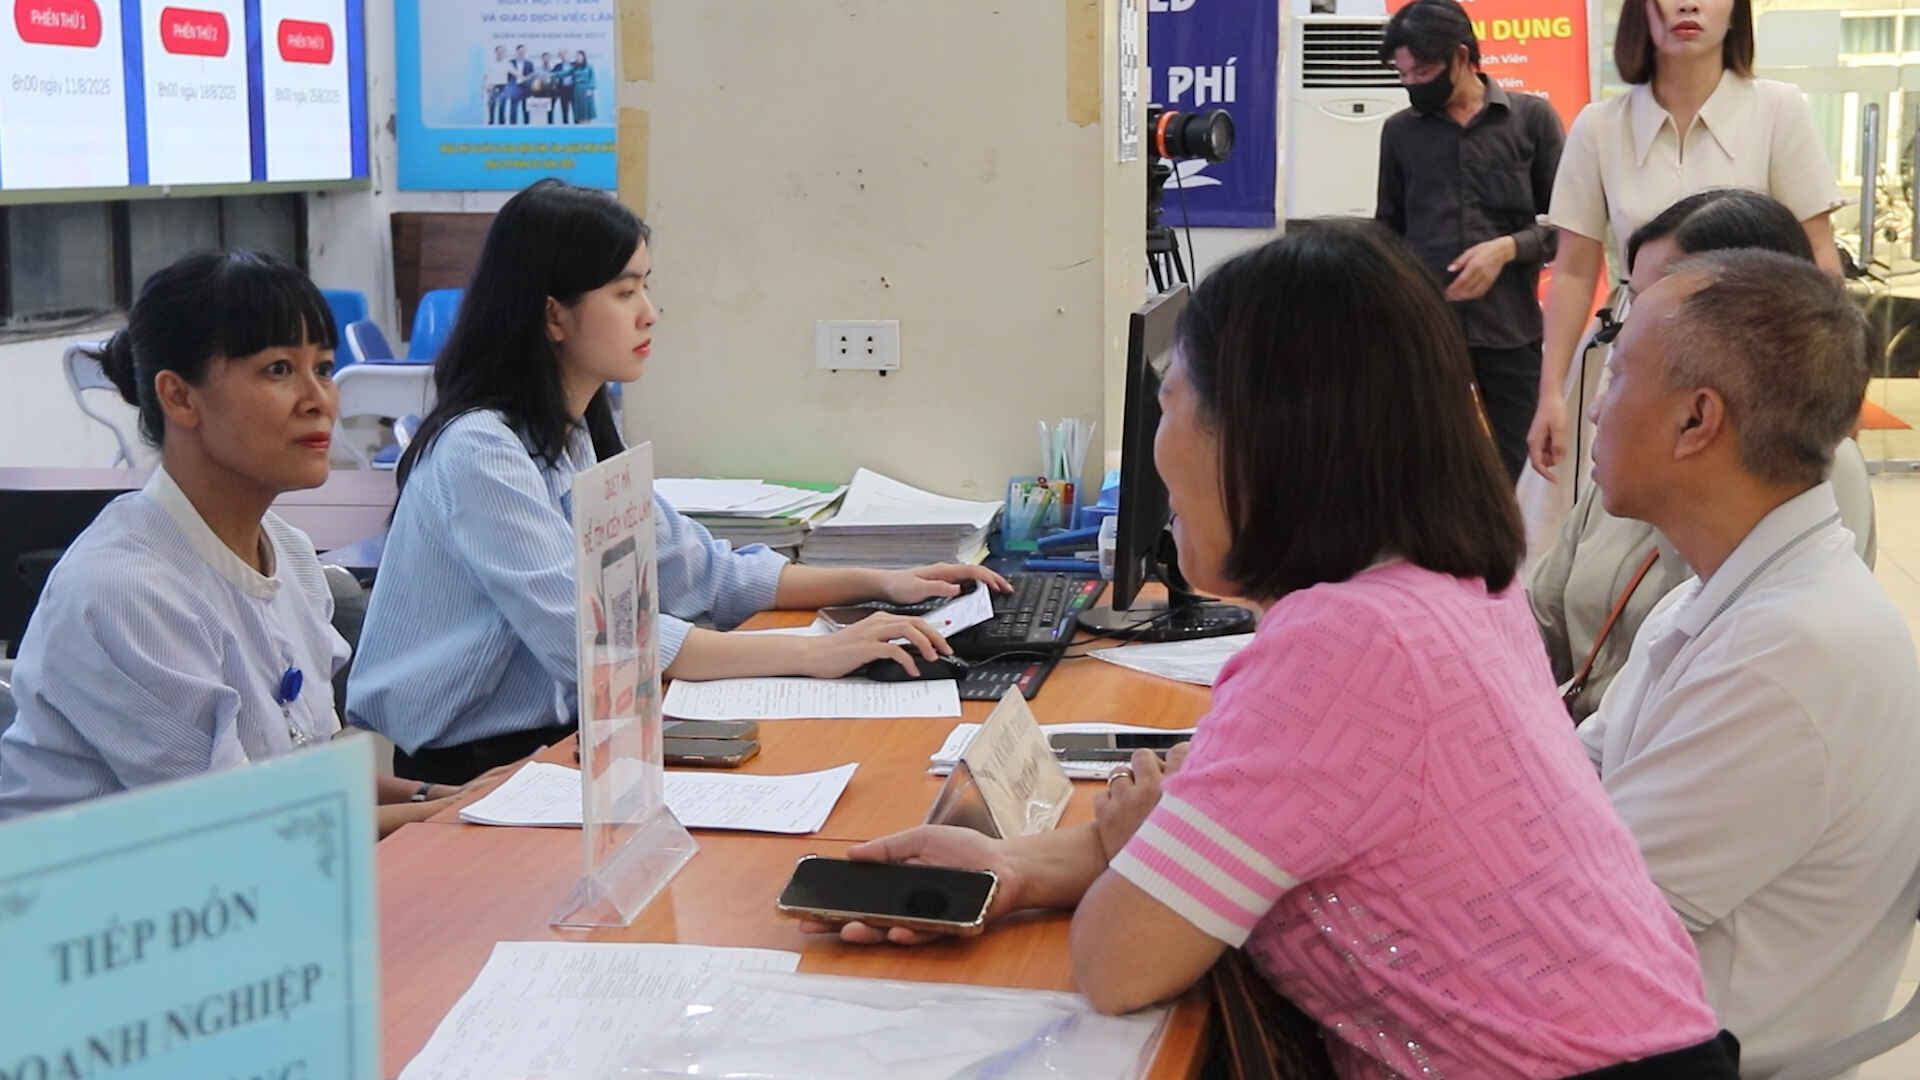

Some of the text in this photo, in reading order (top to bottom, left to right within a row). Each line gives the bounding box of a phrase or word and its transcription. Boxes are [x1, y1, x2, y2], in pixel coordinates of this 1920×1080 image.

[30, 7, 87, 30] PHIÊN THỨ 1
[1492, 16, 1572, 46] DỤNG
[12, 74, 38, 92] 8h00
[1168, 56, 1238, 107] PHÍ
[49, 913, 156, 985] TIẾP
[0, 962, 323, 1080] OANH NGHIỆP
